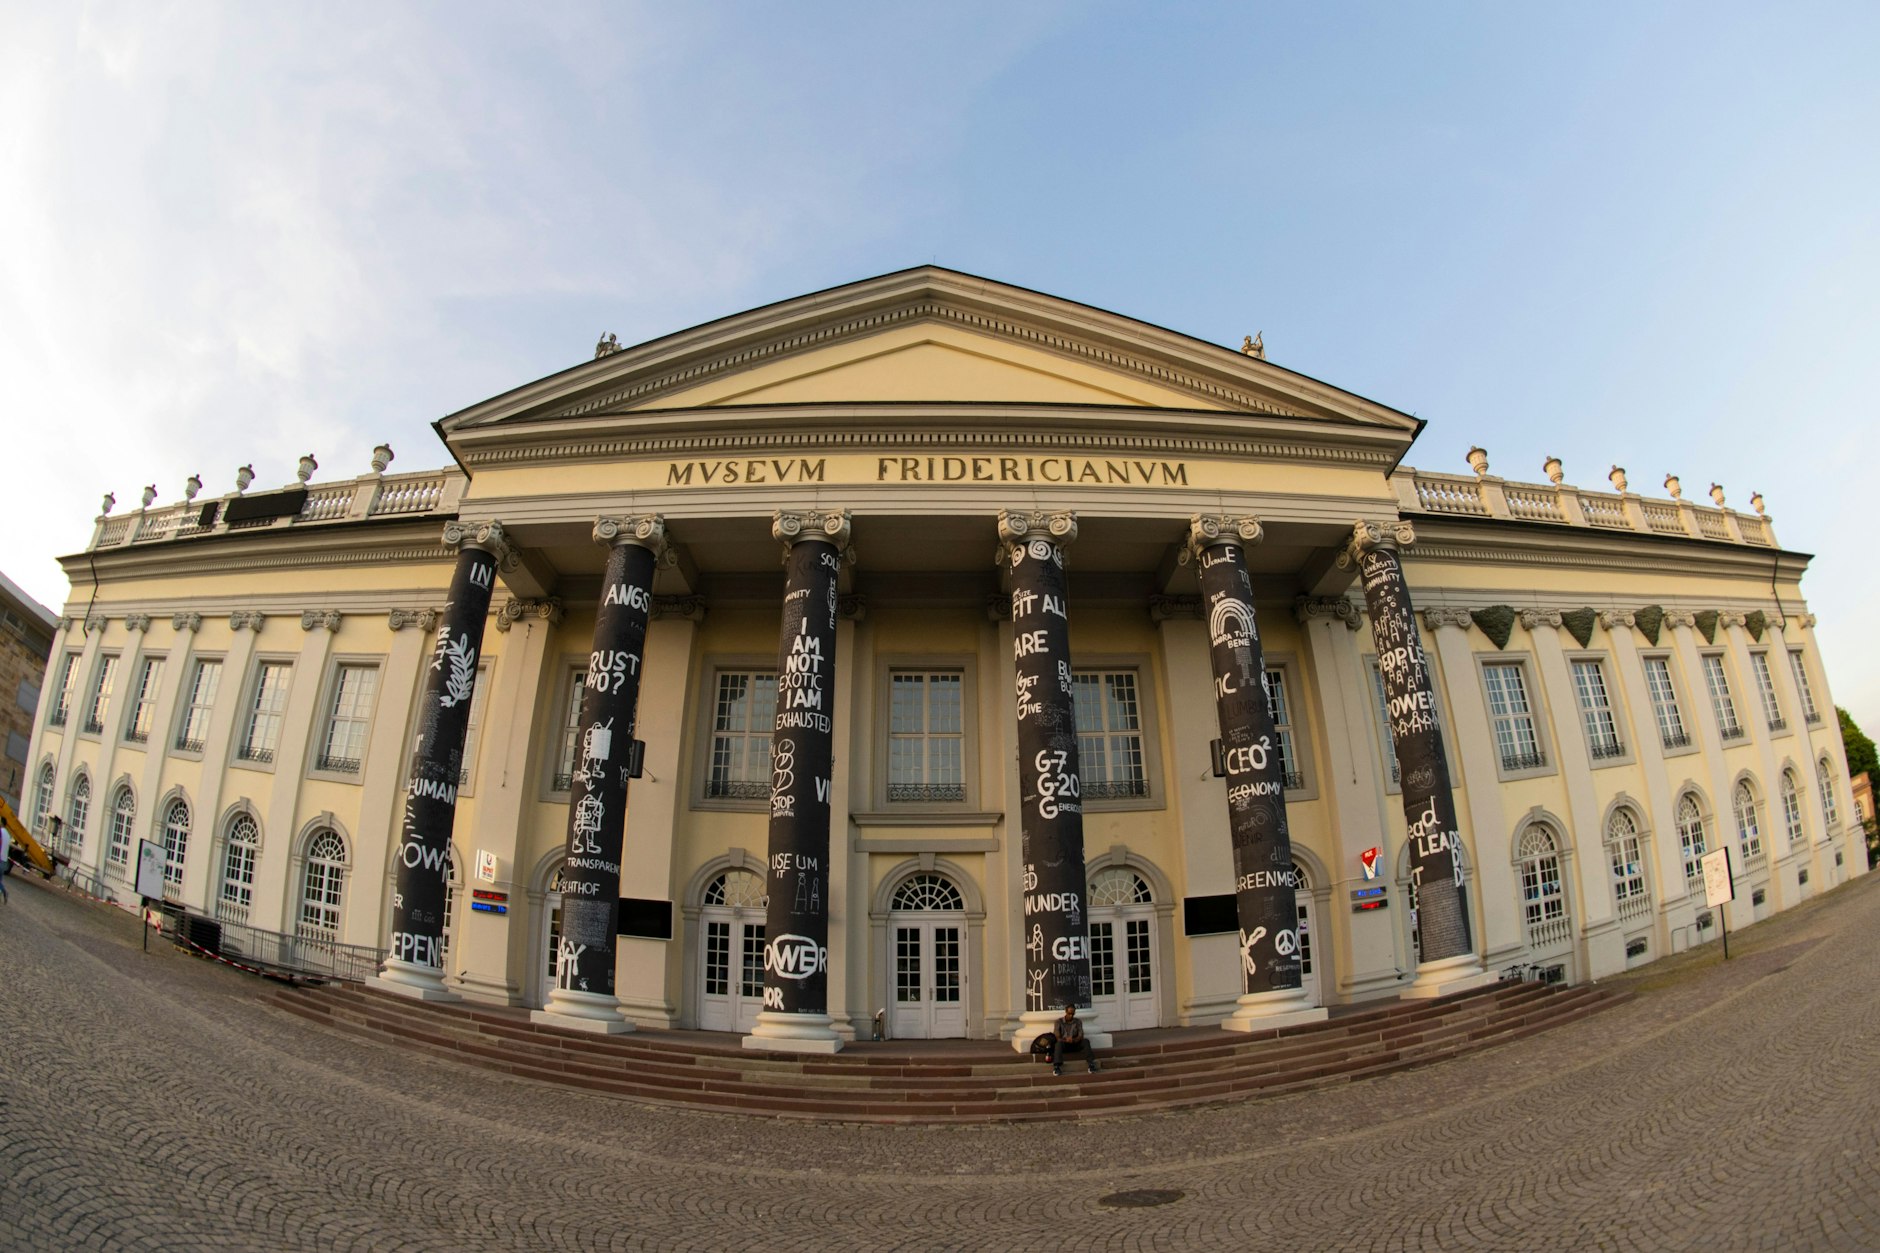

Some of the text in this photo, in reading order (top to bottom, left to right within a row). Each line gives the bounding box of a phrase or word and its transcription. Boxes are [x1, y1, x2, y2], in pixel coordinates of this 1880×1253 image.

[666, 457, 1188, 487] MVSEVM FRIDERICIANVM
[1012, 594, 1039, 623] FIT
[791, 635, 821, 656] AM
[1014, 629, 1050, 661] ARE
[1227, 638, 1251, 649] BENE
[786, 653, 825, 673] NOT
[779, 672, 823, 692] EXOTIC
[792, 688, 822, 710] AM
[776, 712, 832, 734] EXHAUSTED
[1037, 772, 1080, 798] G-20
[1228, 781, 1281, 804] ECONOMY
[772, 794, 796, 811] STOP
[1025, 892, 1080, 916] WUNDER
